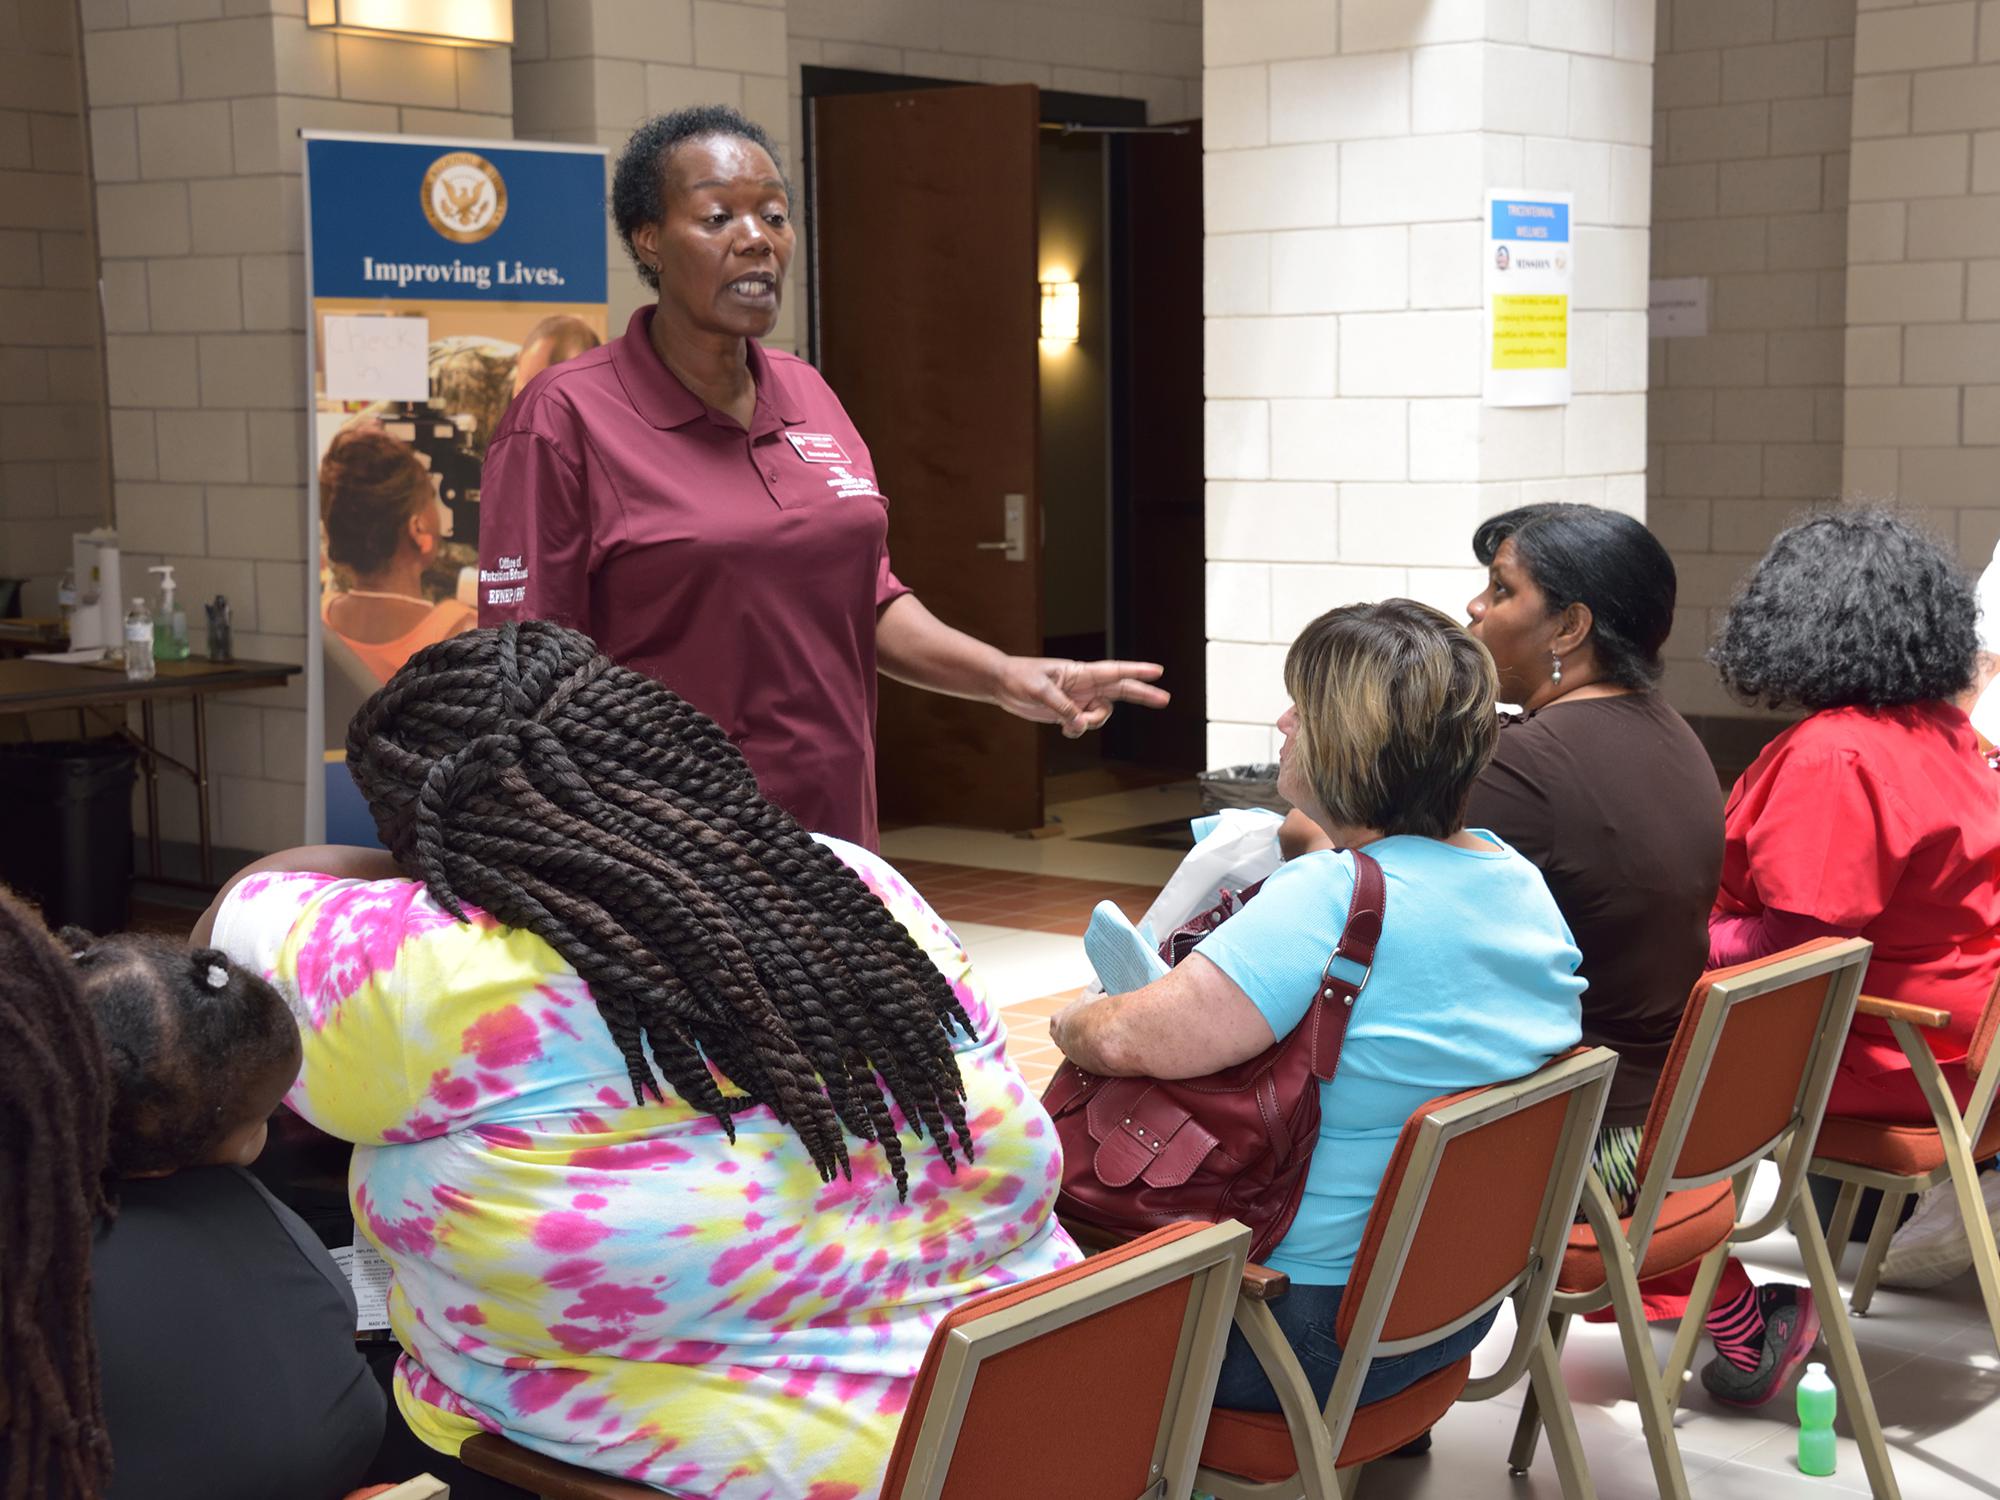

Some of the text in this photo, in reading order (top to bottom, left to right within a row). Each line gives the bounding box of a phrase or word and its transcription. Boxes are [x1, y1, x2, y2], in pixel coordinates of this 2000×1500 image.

[363, 257, 565, 289] Improving Lives.
[499, 557, 516, 569] Office
